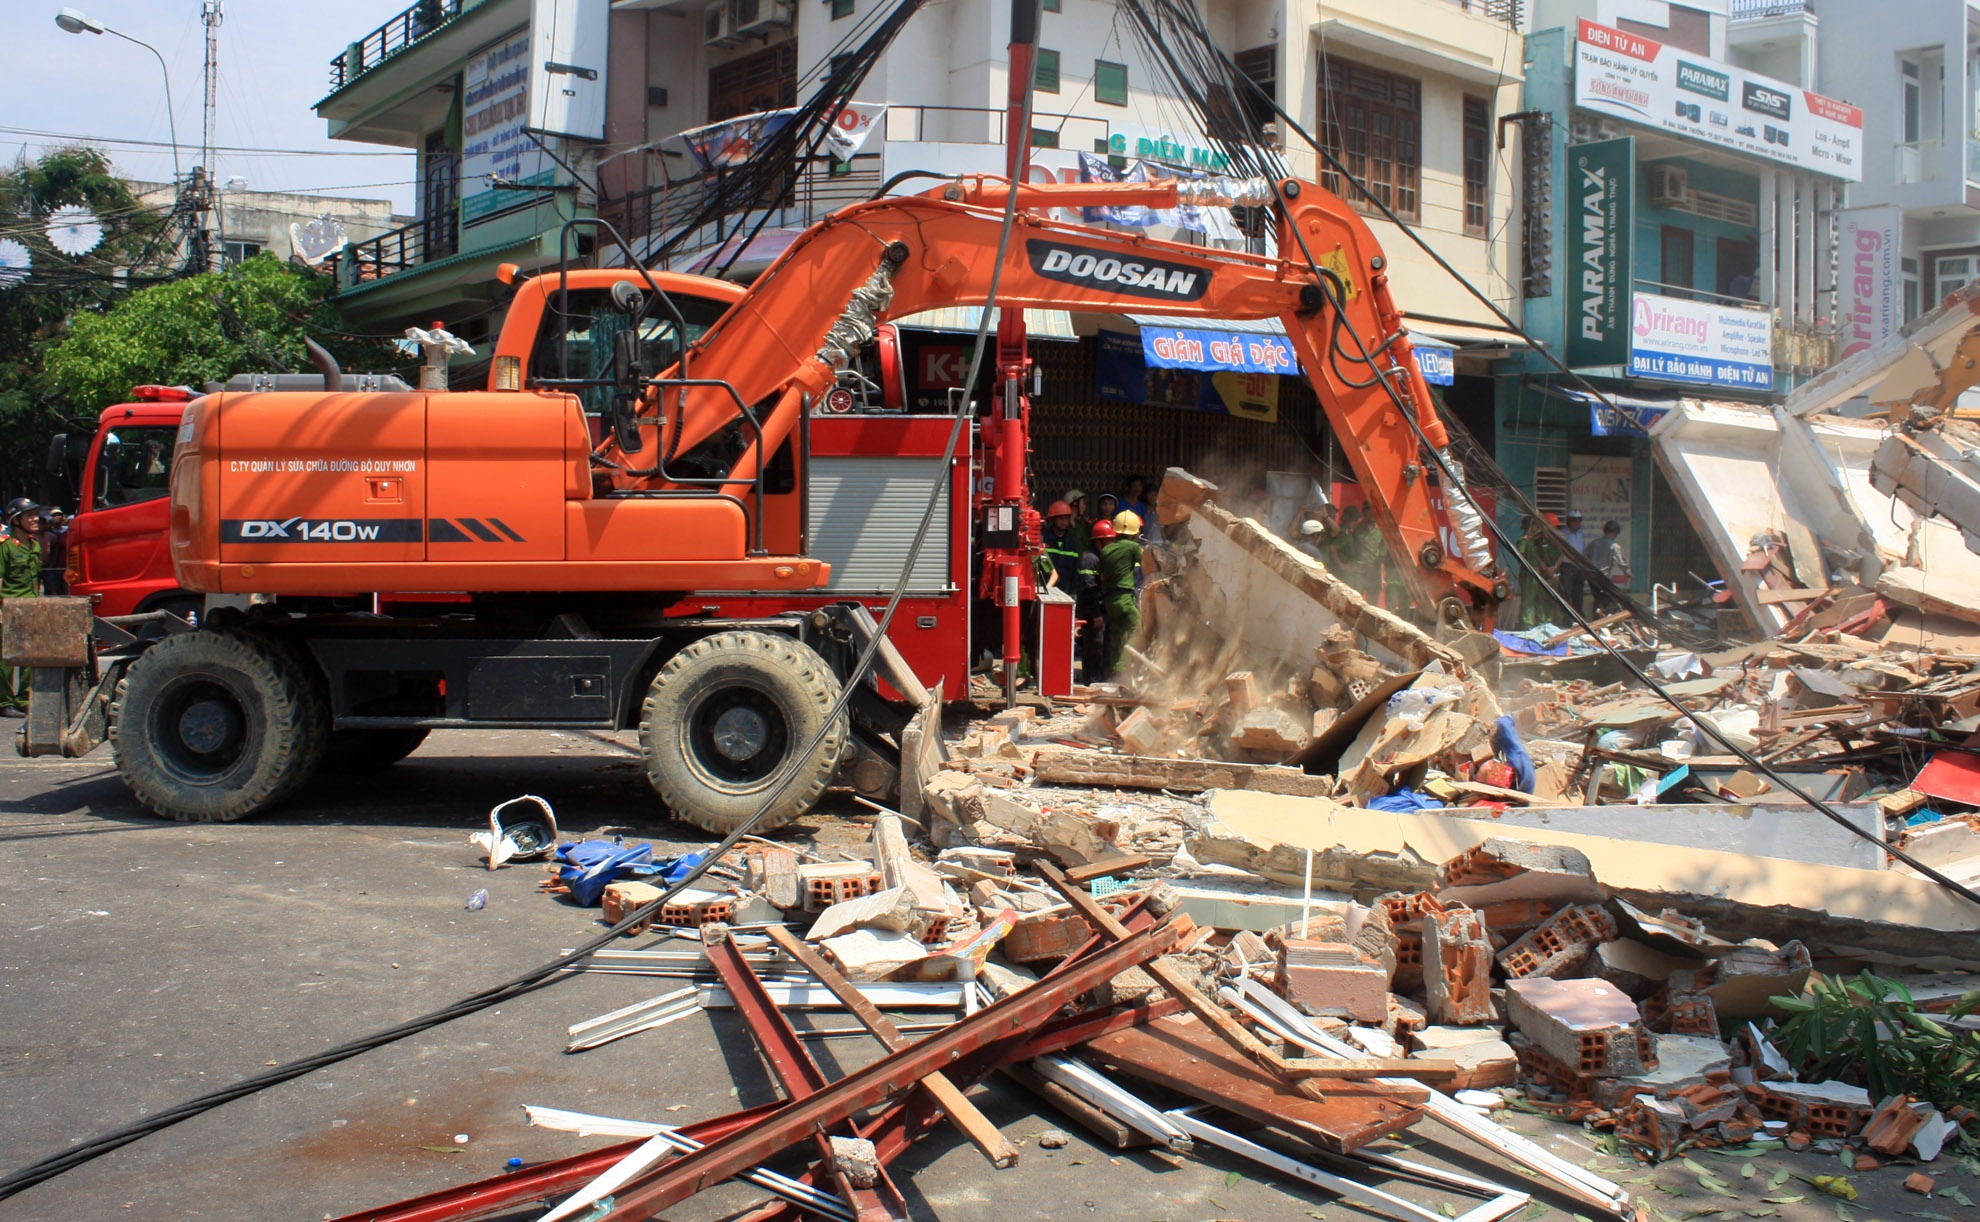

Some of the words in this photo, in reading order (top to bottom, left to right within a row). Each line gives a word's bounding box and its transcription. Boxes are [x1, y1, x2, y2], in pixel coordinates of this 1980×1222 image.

[1587, 27, 1610, 46] ĐIỆN
[1614, 34, 1628, 51] TỬ
[1631, 41, 1645, 56] AN
[1680, 67, 1728, 92] PARAMAX
[1815, 130, 1828, 143] Loa
[1811, 145, 1830, 159] Micro
[1835, 152, 1853, 166] Mixer
[1579, 167, 1605, 341] PARAMAX
[1041, 249, 1197, 295] DOOSAN
[1842, 229, 1882, 354] rirang
[1633, 297, 1708, 345] Arirang
[1153, 332, 1204, 363] GIẢM
[1209, 336, 1245, 367] GIÁ
[1249, 338, 1289, 373] ĐẶC
[1642, 338, 1708, 352] www.arirang.com.vn
[1420, 352, 1439, 373] LED
[1633, 357, 1650, 372] ĐẠI
[1652, 357, 1664, 372] LÝ
[1666, 357, 1686, 373] BẢO
[1688, 361, 1713, 377] HÀNH
[1717, 365, 1740, 384] ĐIỆN
[1742, 366, 1755, 382] TỬ
[1755, 371, 1769, 384] AN
[230, 460, 250, 472] C.TY
[251, 457, 275, 472] QUẢN
[275, 458, 287, 472] LÝ
[287, 456, 305, 472] SỬA
[306, 458, 328, 472] CHỮA
[330, 457, 359, 472] ĐƯỜNG
[360, 458, 372, 474] BỘ
[374, 460, 390, 472] QUY
[392, 459, 416, 472] NHƠN
